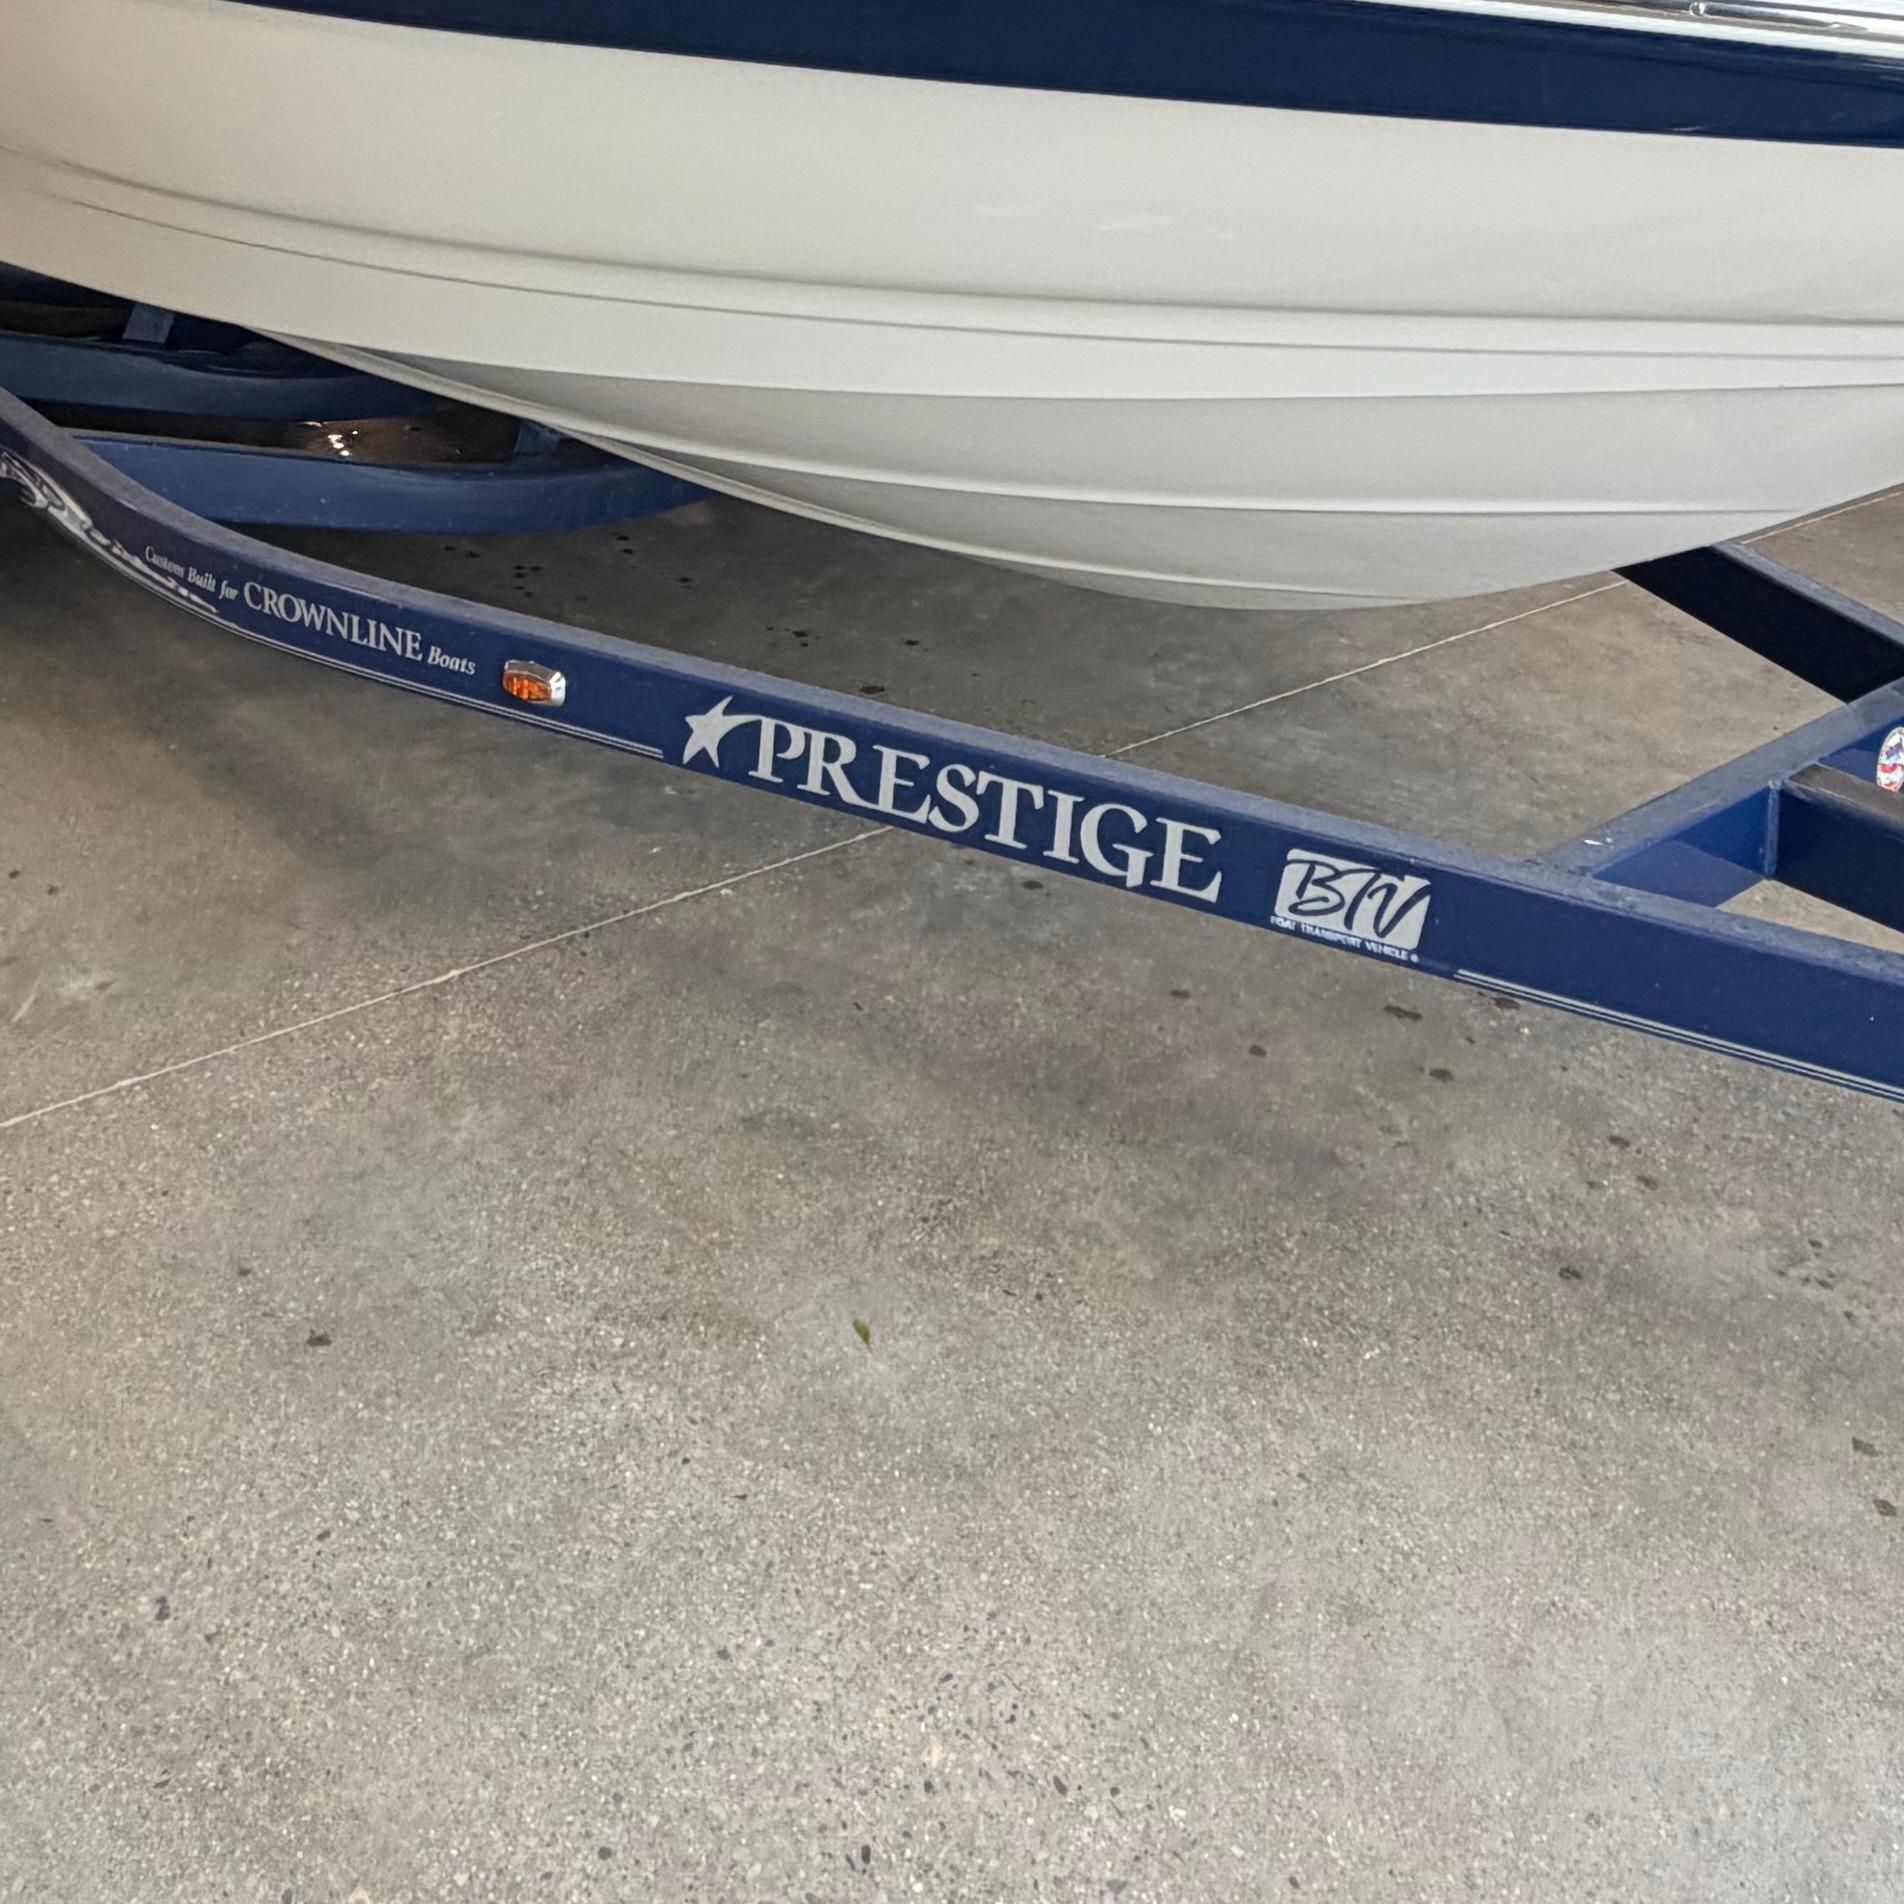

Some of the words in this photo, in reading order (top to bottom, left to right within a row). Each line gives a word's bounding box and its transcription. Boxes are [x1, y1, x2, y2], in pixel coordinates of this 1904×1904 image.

[145, 546, 185, 578] Custom
[188, 566, 216, 592] Built
[218, 579, 238, 600] for
[243, 581, 423, 662] CROWNLINE
[427, 645, 476, 676] Boats
[746, 713, 1223, 903] PRESTIGE
[1287, 859, 1432, 938] BTV
